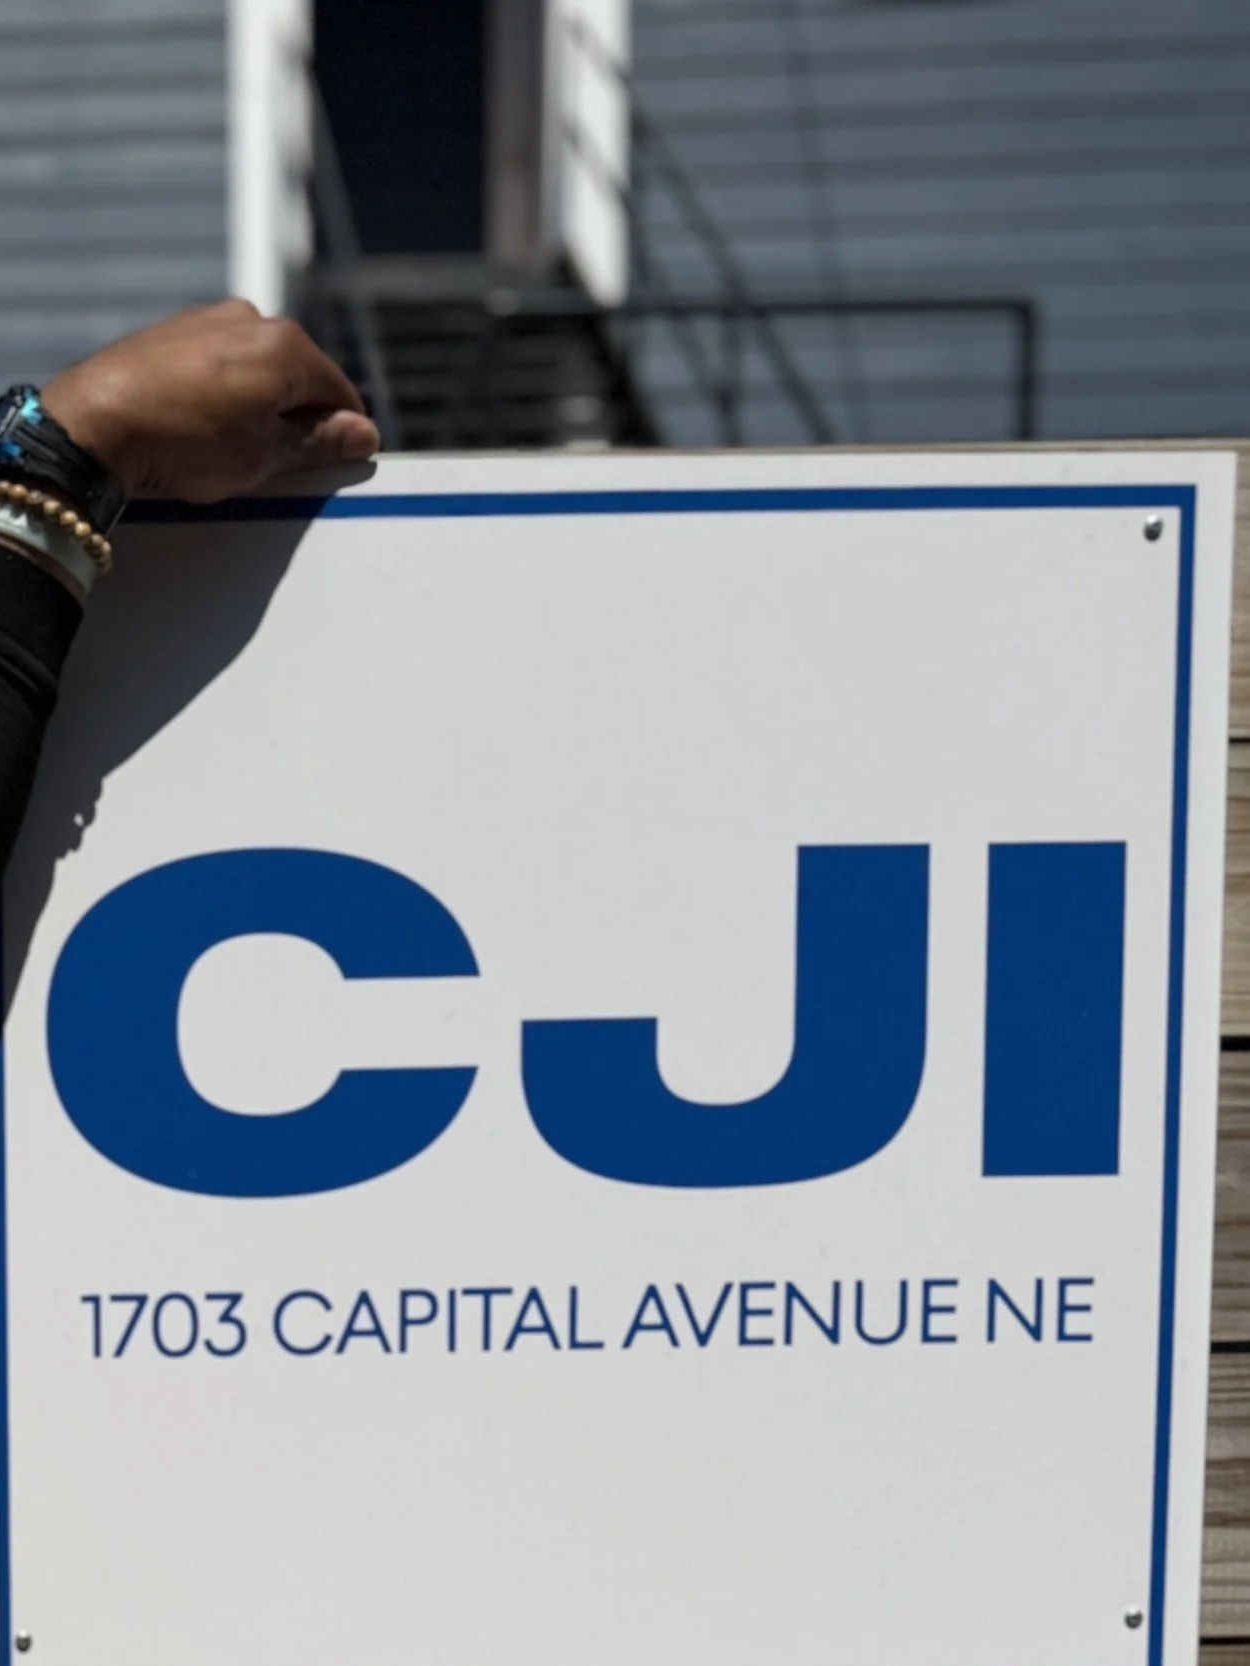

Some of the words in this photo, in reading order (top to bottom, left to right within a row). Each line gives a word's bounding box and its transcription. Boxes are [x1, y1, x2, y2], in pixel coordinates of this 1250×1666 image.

[46, 841, 1127, 1199] CJI
[80, 1292, 247, 1358] 1703
[272, 1286, 605, 1356] CAPITAL
[621, 1279, 959, 1348] AVENUE
[986, 1277, 1094, 1343] NE
